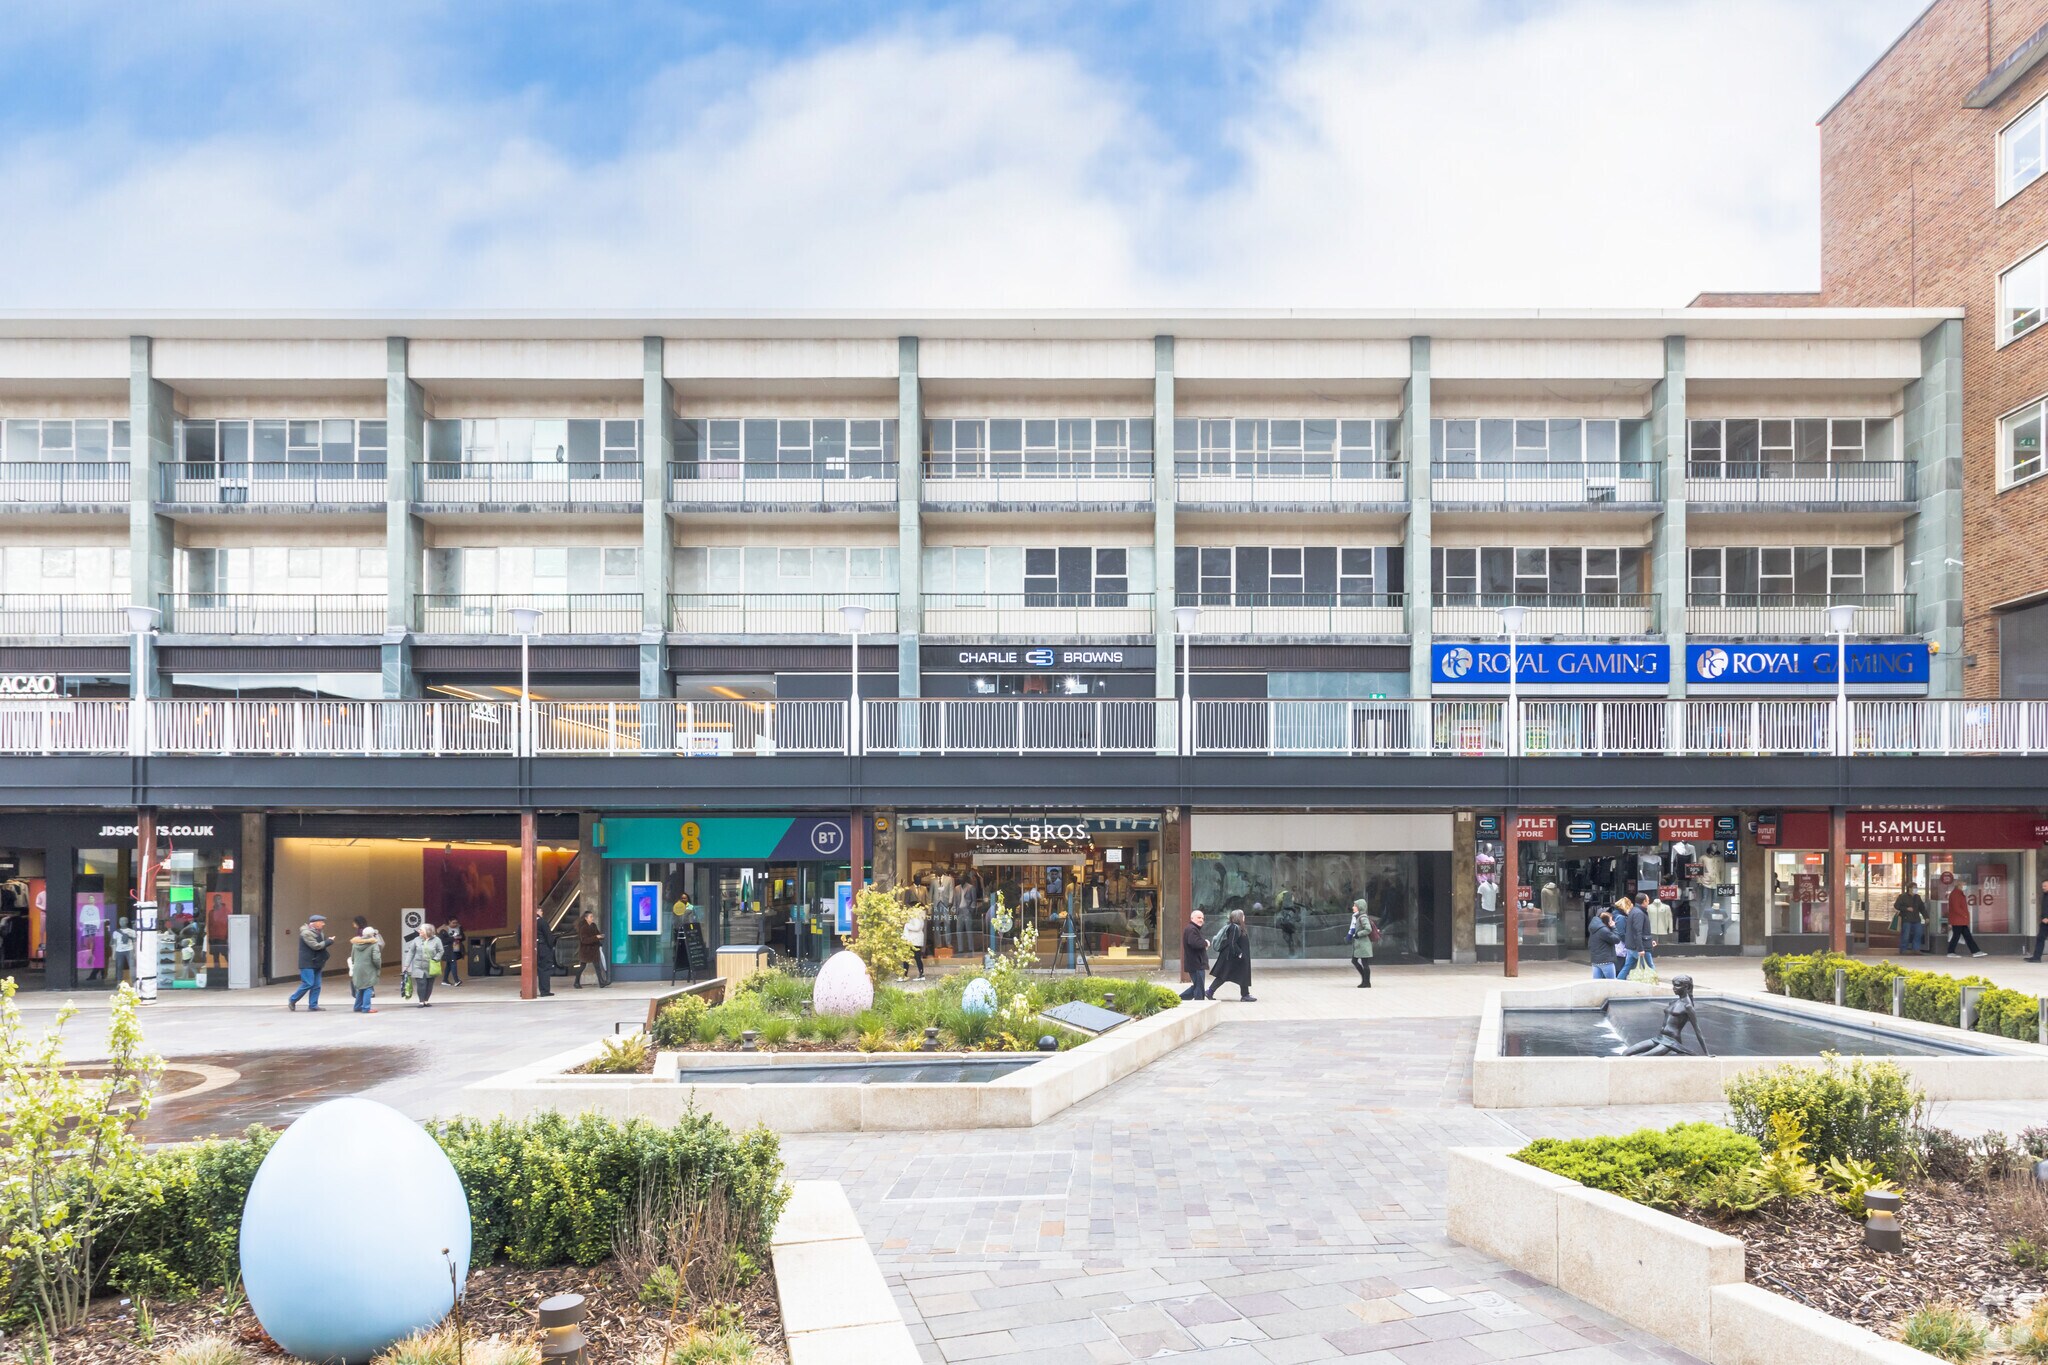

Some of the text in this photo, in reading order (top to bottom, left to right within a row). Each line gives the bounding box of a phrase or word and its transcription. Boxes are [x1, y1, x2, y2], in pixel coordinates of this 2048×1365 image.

[959, 652, 1017, 663] CHARLIE
[1064, 652, 1123, 663] BROWNS
[1733, 653, 1804, 673] ROYAL
[1478, 653, 1657, 674] ROYAL GAMING
[1517, 818, 1556, 828] UTLET
[1600, 823, 1653, 831] CHARLIE
[1659, 818, 1711, 829] OUTLET
[965, 824, 1091, 840] MOSS BROS.
[818, 832, 836, 844] BT
[1889, 835, 1945, 843] JEWELLER
[1660, 889, 1676, 897] Sale
[1718, 886, 1734, 894] Sale
[1967, 889, 1994, 905] ale
